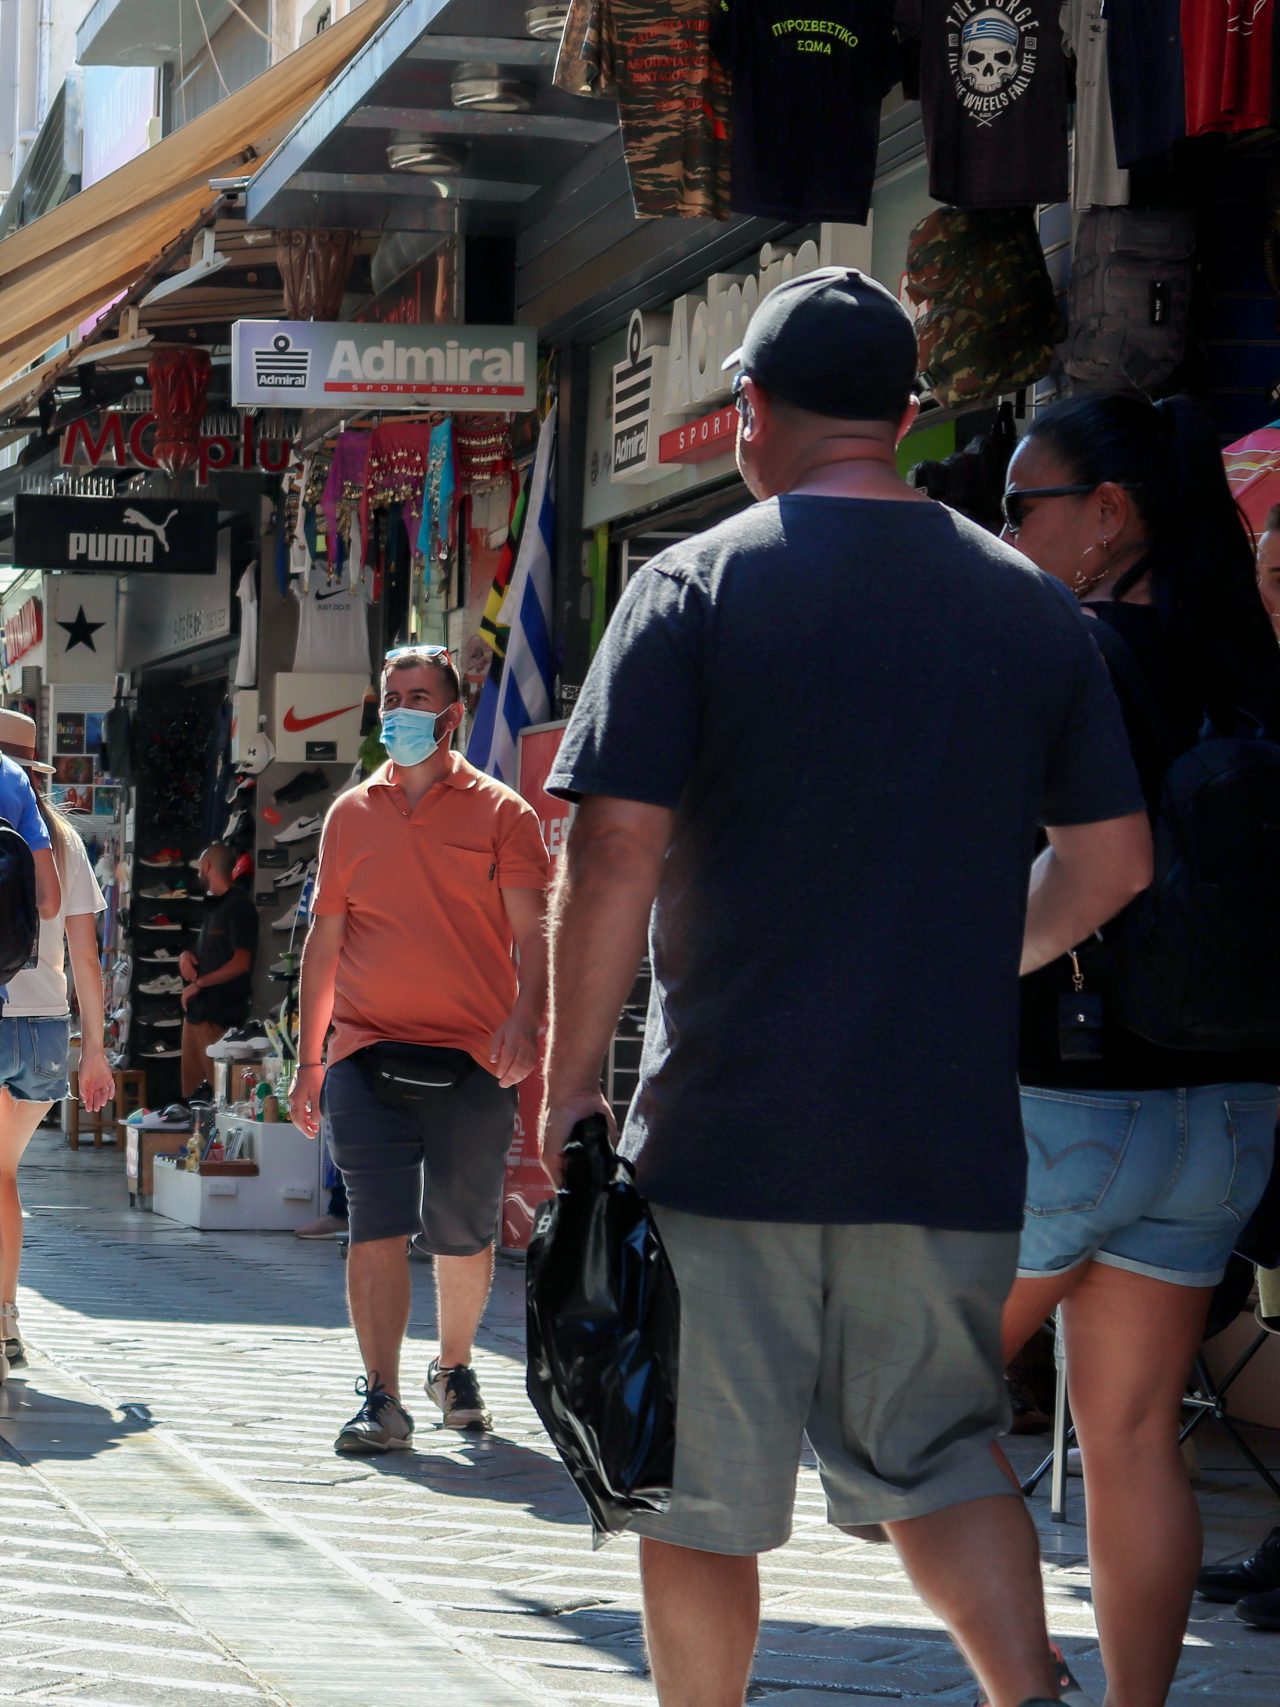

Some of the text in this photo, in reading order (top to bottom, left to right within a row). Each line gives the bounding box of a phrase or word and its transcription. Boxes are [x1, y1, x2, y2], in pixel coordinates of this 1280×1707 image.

[947, 0, 976, 28] THE
[772, 20, 858, 47] ΠΥΡΟΣΒΕΣΤΙΚΟ
[797, 40, 831, 54] ΣΩΜΑ
[963, 92, 1009, 111] WHEELS
[1008, 75, 1031, 100] FALL
[1021, 52, 1037, 74] OFF
[326, 340, 525, 383] Admiral
[258, 373, 306, 387] Admiral
[351, 384, 498, 394] SPORT SHOPS
[614, 424, 648, 464] Admiral
[678, 411, 732, 450] SPORT
[196, 415, 304, 487] plu
[68, 532, 154, 563] PUMA
[317, 603, 350, 611] JUST DO IT
